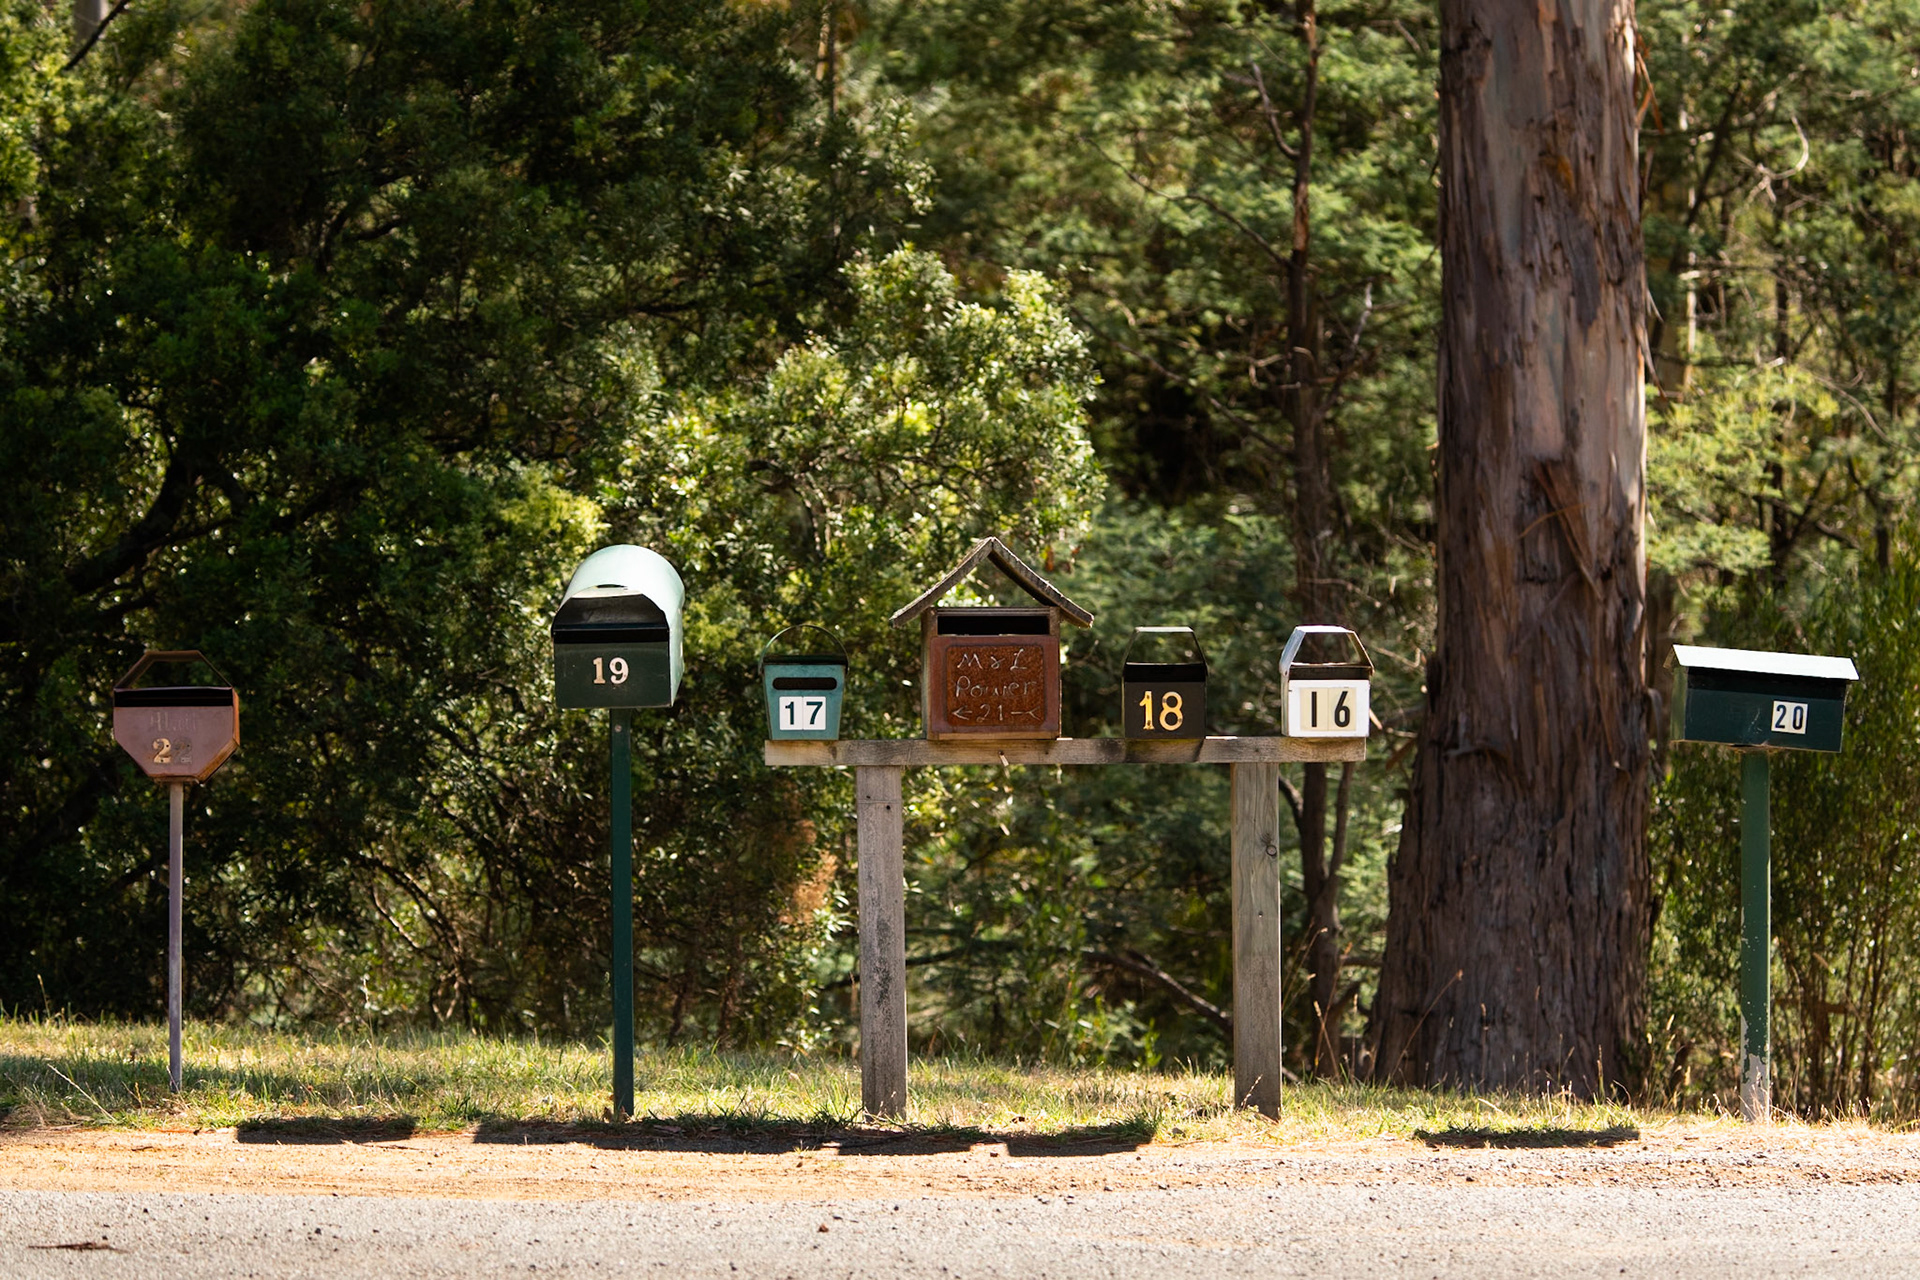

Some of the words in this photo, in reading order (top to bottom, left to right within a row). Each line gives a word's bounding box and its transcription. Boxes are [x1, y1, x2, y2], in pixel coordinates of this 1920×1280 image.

[592, 656, 629, 685] 19
[956, 652, 983, 670] M
[784, 701, 823, 726] 17
[976, 703, 1004, 723] 21
[1138, 690, 1184, 731] 18
[1311, 690, 1351, 728] 16
[1774, 703, 1805, 731] 20
